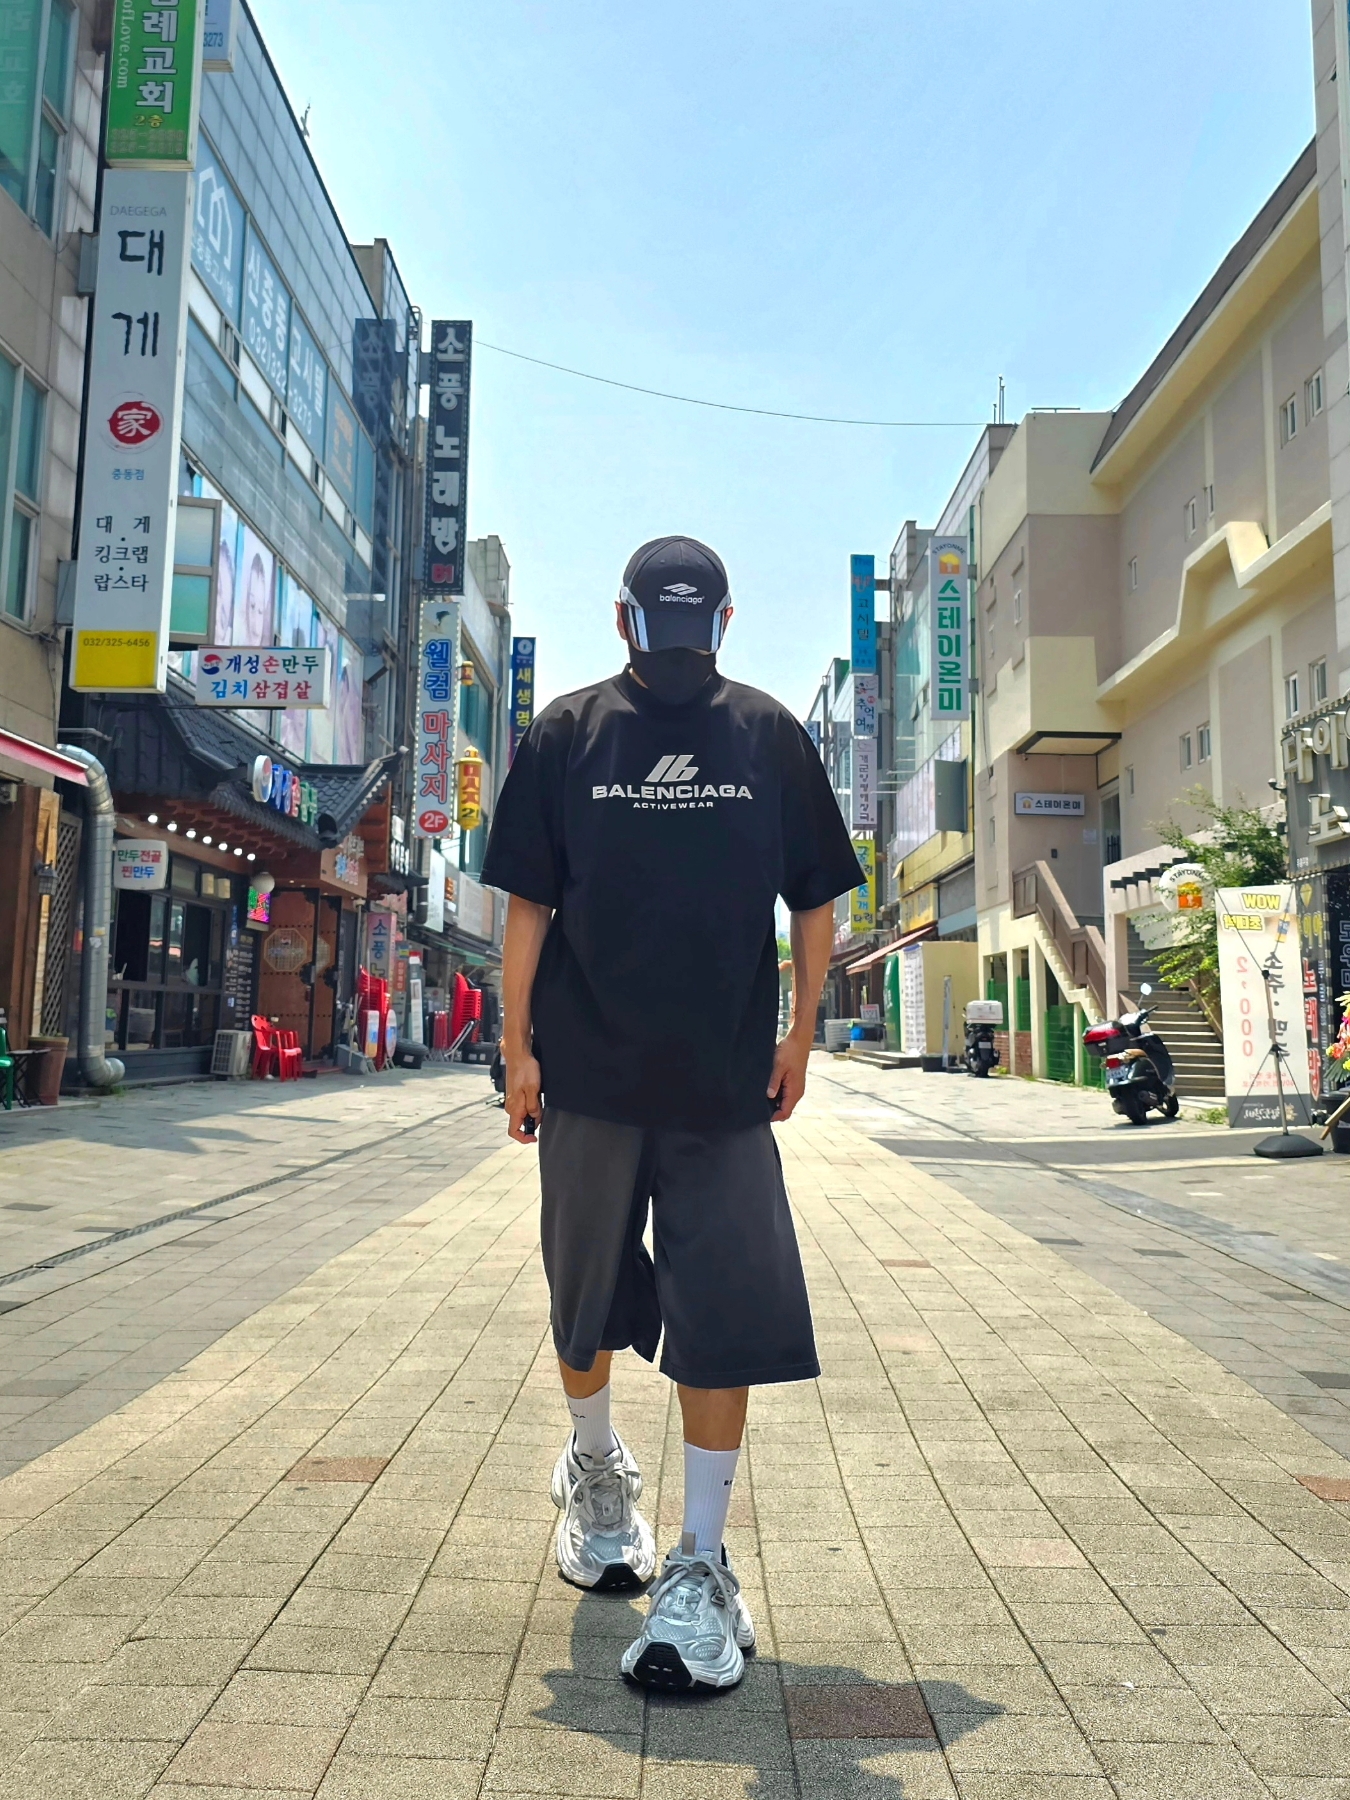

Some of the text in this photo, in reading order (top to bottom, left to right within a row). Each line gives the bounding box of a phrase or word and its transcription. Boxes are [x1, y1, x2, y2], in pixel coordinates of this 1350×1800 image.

[134, 114, 163, 128] 2층
[110, 205, 167, 217] DAEGEGA
[117, 409, 152, 437] 家
[111, 468, 145, 481] 중동점
[95, 545, 149, 564] 킹크랩
[94, 574, 149, 593] 랍스타
[659, 594, 704, 605] balenciaga
[83, 637, 150, 648] 032/325-6456
[937, 579, 962, 711] 스테이온미
[225, 654, 319, 675] 개성손만두
[210, 678, 312, 700] 김치삼겹살
[592, 784, 753, 800] BALENCIAGA
[633, 801, 714, 810] ACTIVEWEAR
[1035, 799, 1081, 810] 스테이온미
[423, 813, 446, 828] 2F
[117, 850, 162, 863] 만두전골
